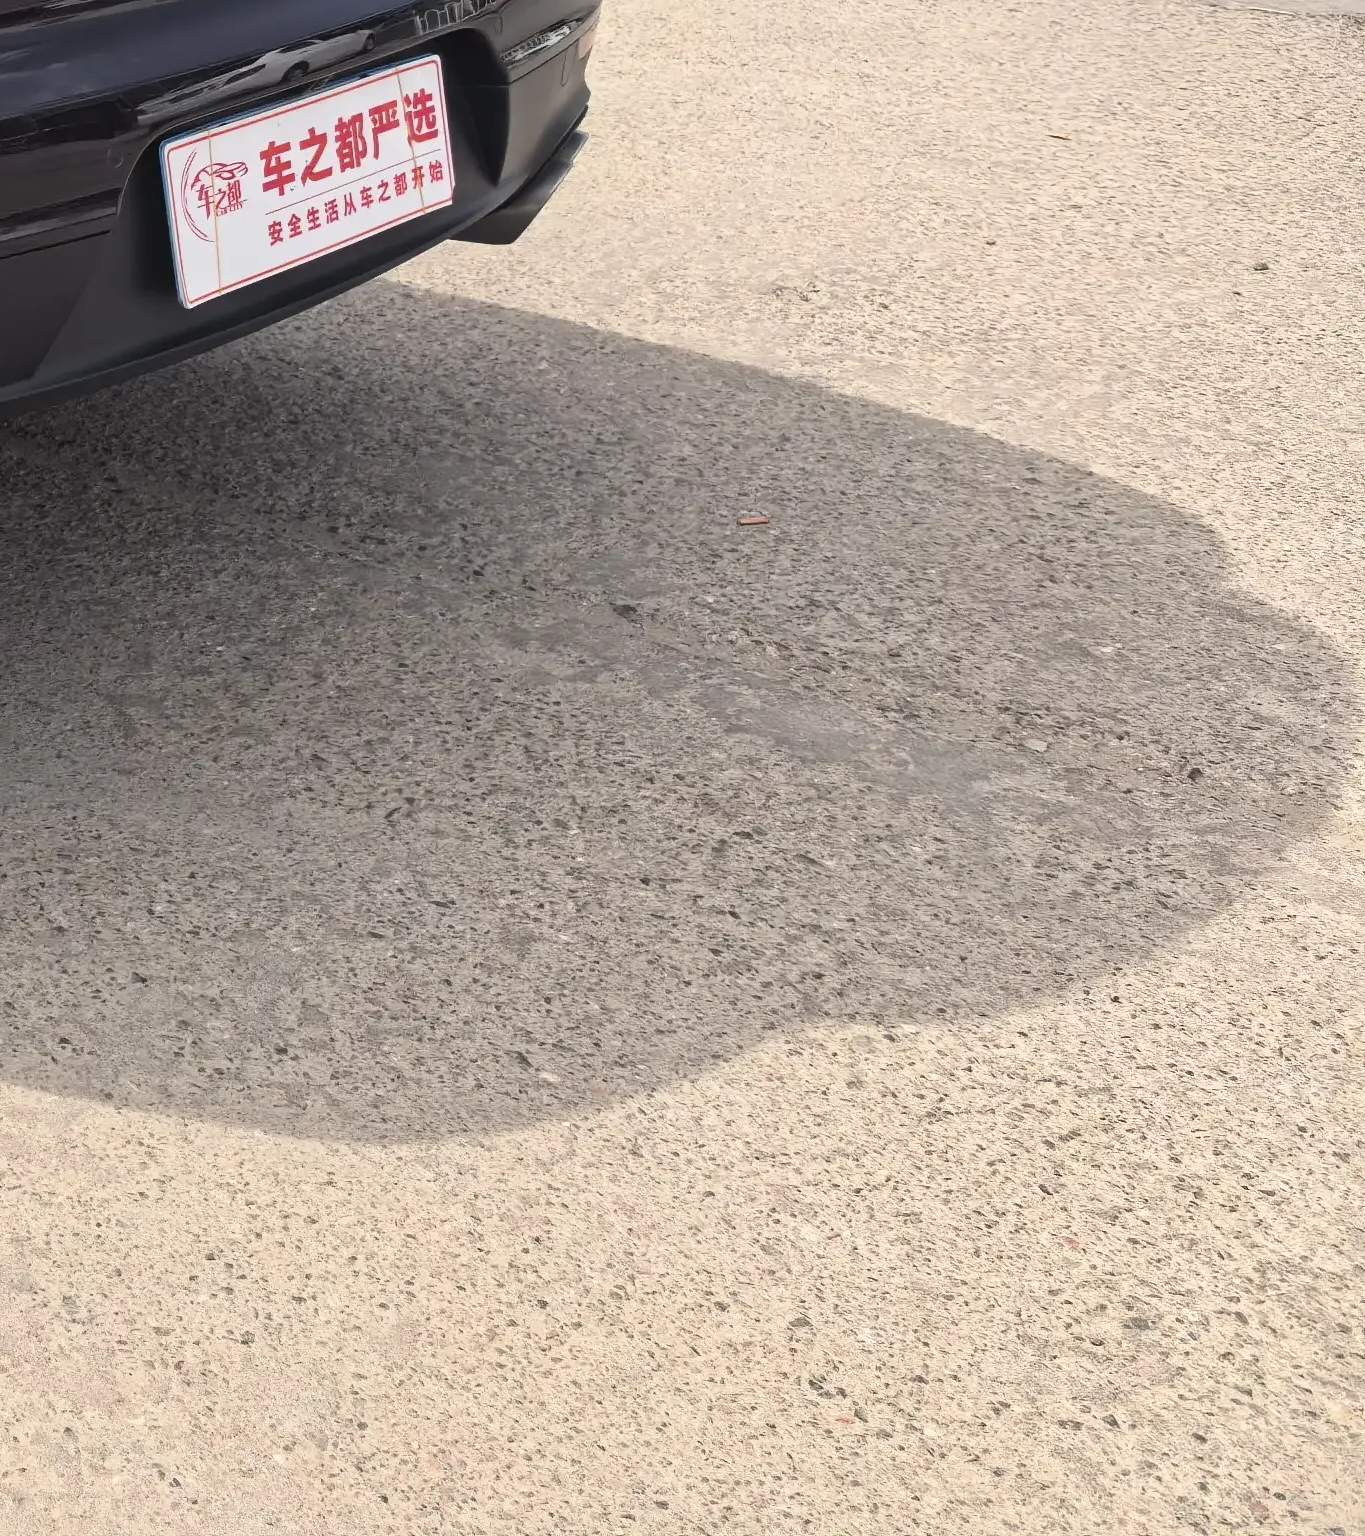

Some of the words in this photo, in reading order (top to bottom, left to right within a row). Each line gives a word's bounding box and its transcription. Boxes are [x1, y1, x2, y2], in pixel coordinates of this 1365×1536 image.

[259, 88, 440, 197] 车之都严选
[267, 159, 445, 247] 安全生活从车之都开始
